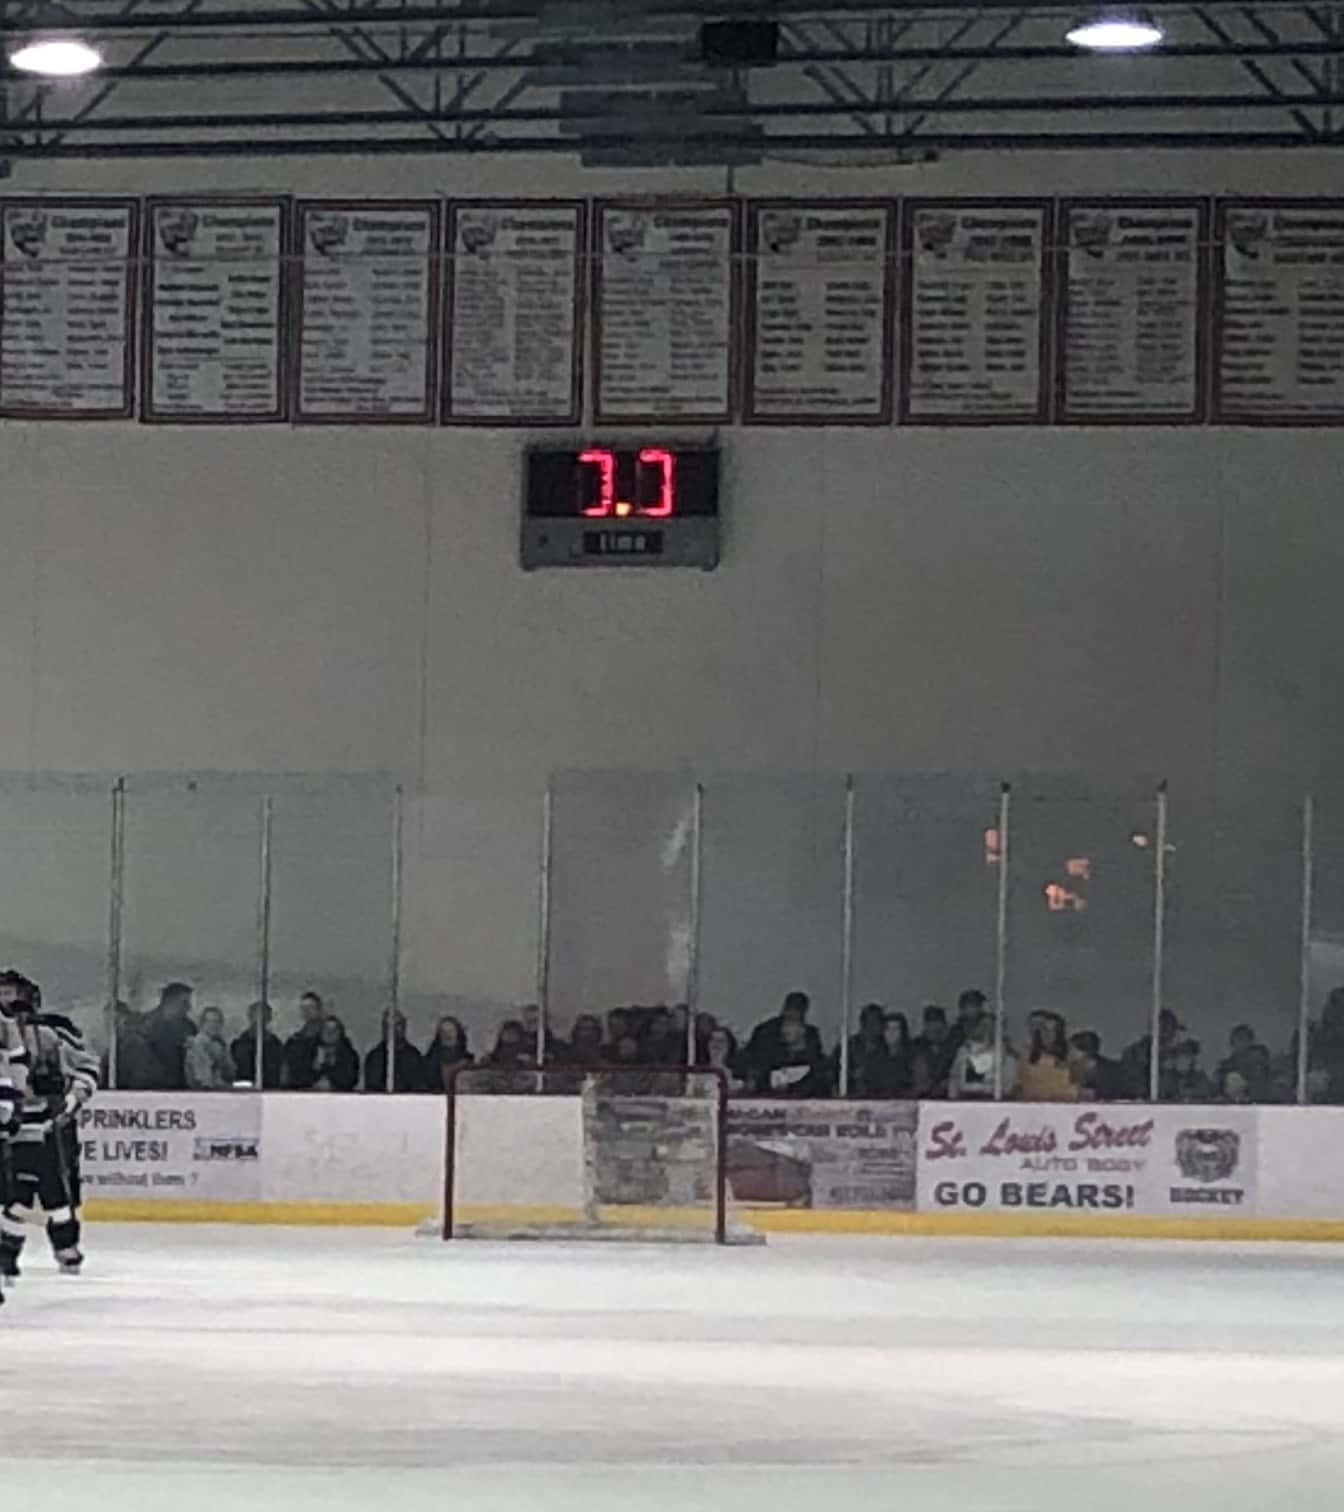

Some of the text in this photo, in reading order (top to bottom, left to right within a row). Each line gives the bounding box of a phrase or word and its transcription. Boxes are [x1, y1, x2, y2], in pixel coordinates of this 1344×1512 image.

[81, 1109, 197, 1130] PRINKLERS
[979, 1117, 1057, 1156] Louis
[1068, 1111, 1155, 1151] Street
[103, 1141, 168, 1161] LIVES!
[1020, 1158, 1149, 1172] AUTO BODY
[934, 1182, 986, 1207] GO
[1001, 1183, 1135, 1209] BEARS!
